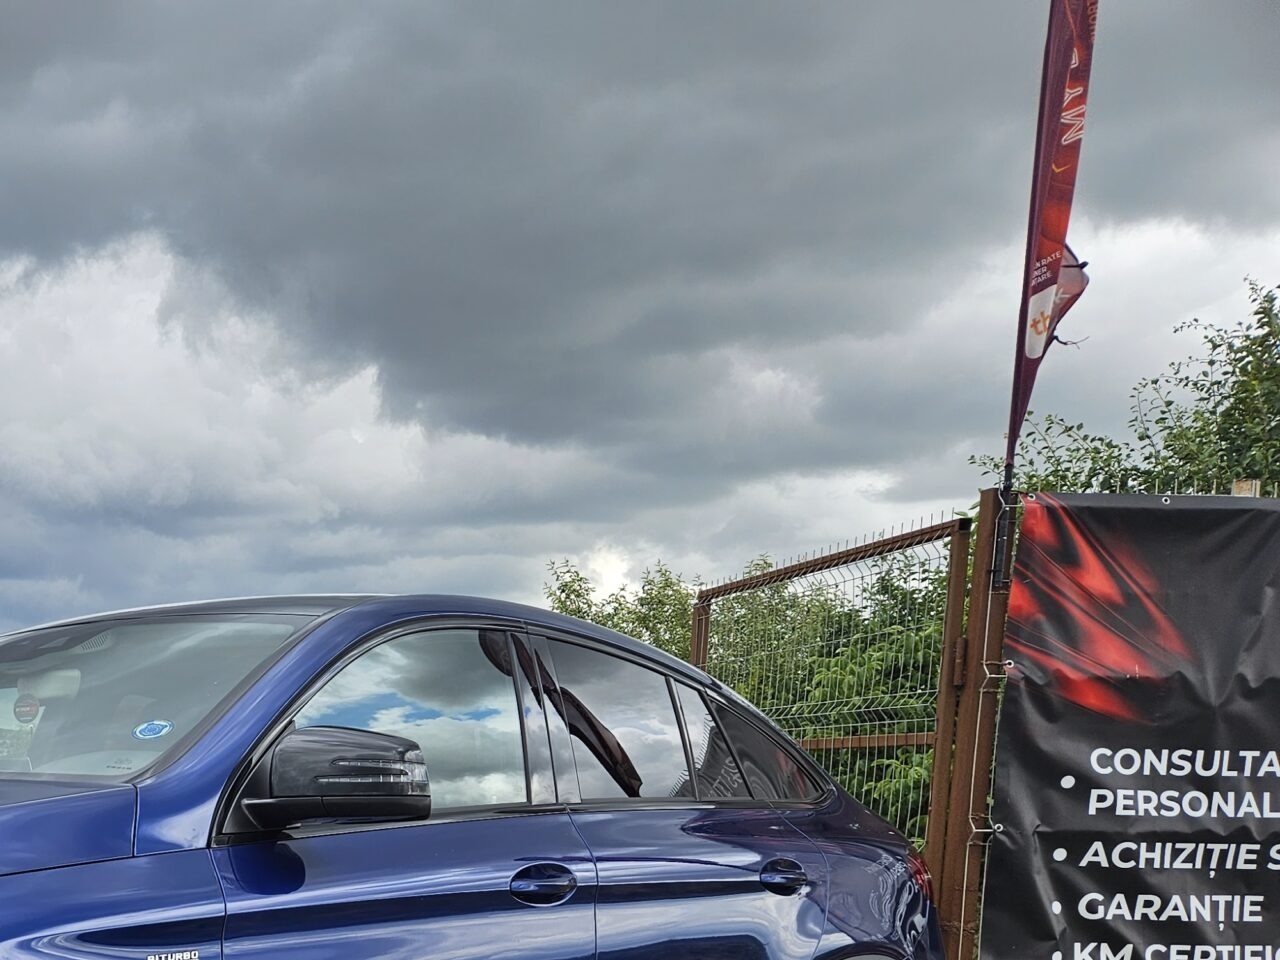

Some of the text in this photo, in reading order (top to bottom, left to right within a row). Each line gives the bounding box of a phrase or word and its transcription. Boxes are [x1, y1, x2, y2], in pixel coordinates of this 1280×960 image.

[1090, 747, 1280, 778] CONSULTA
[1087, 788, 1280, 818] PERSONAL
[1078, 840, 1261, 879] ACHIZIȚIE
[1077, 892, 1263, 931] GARANȚIE
